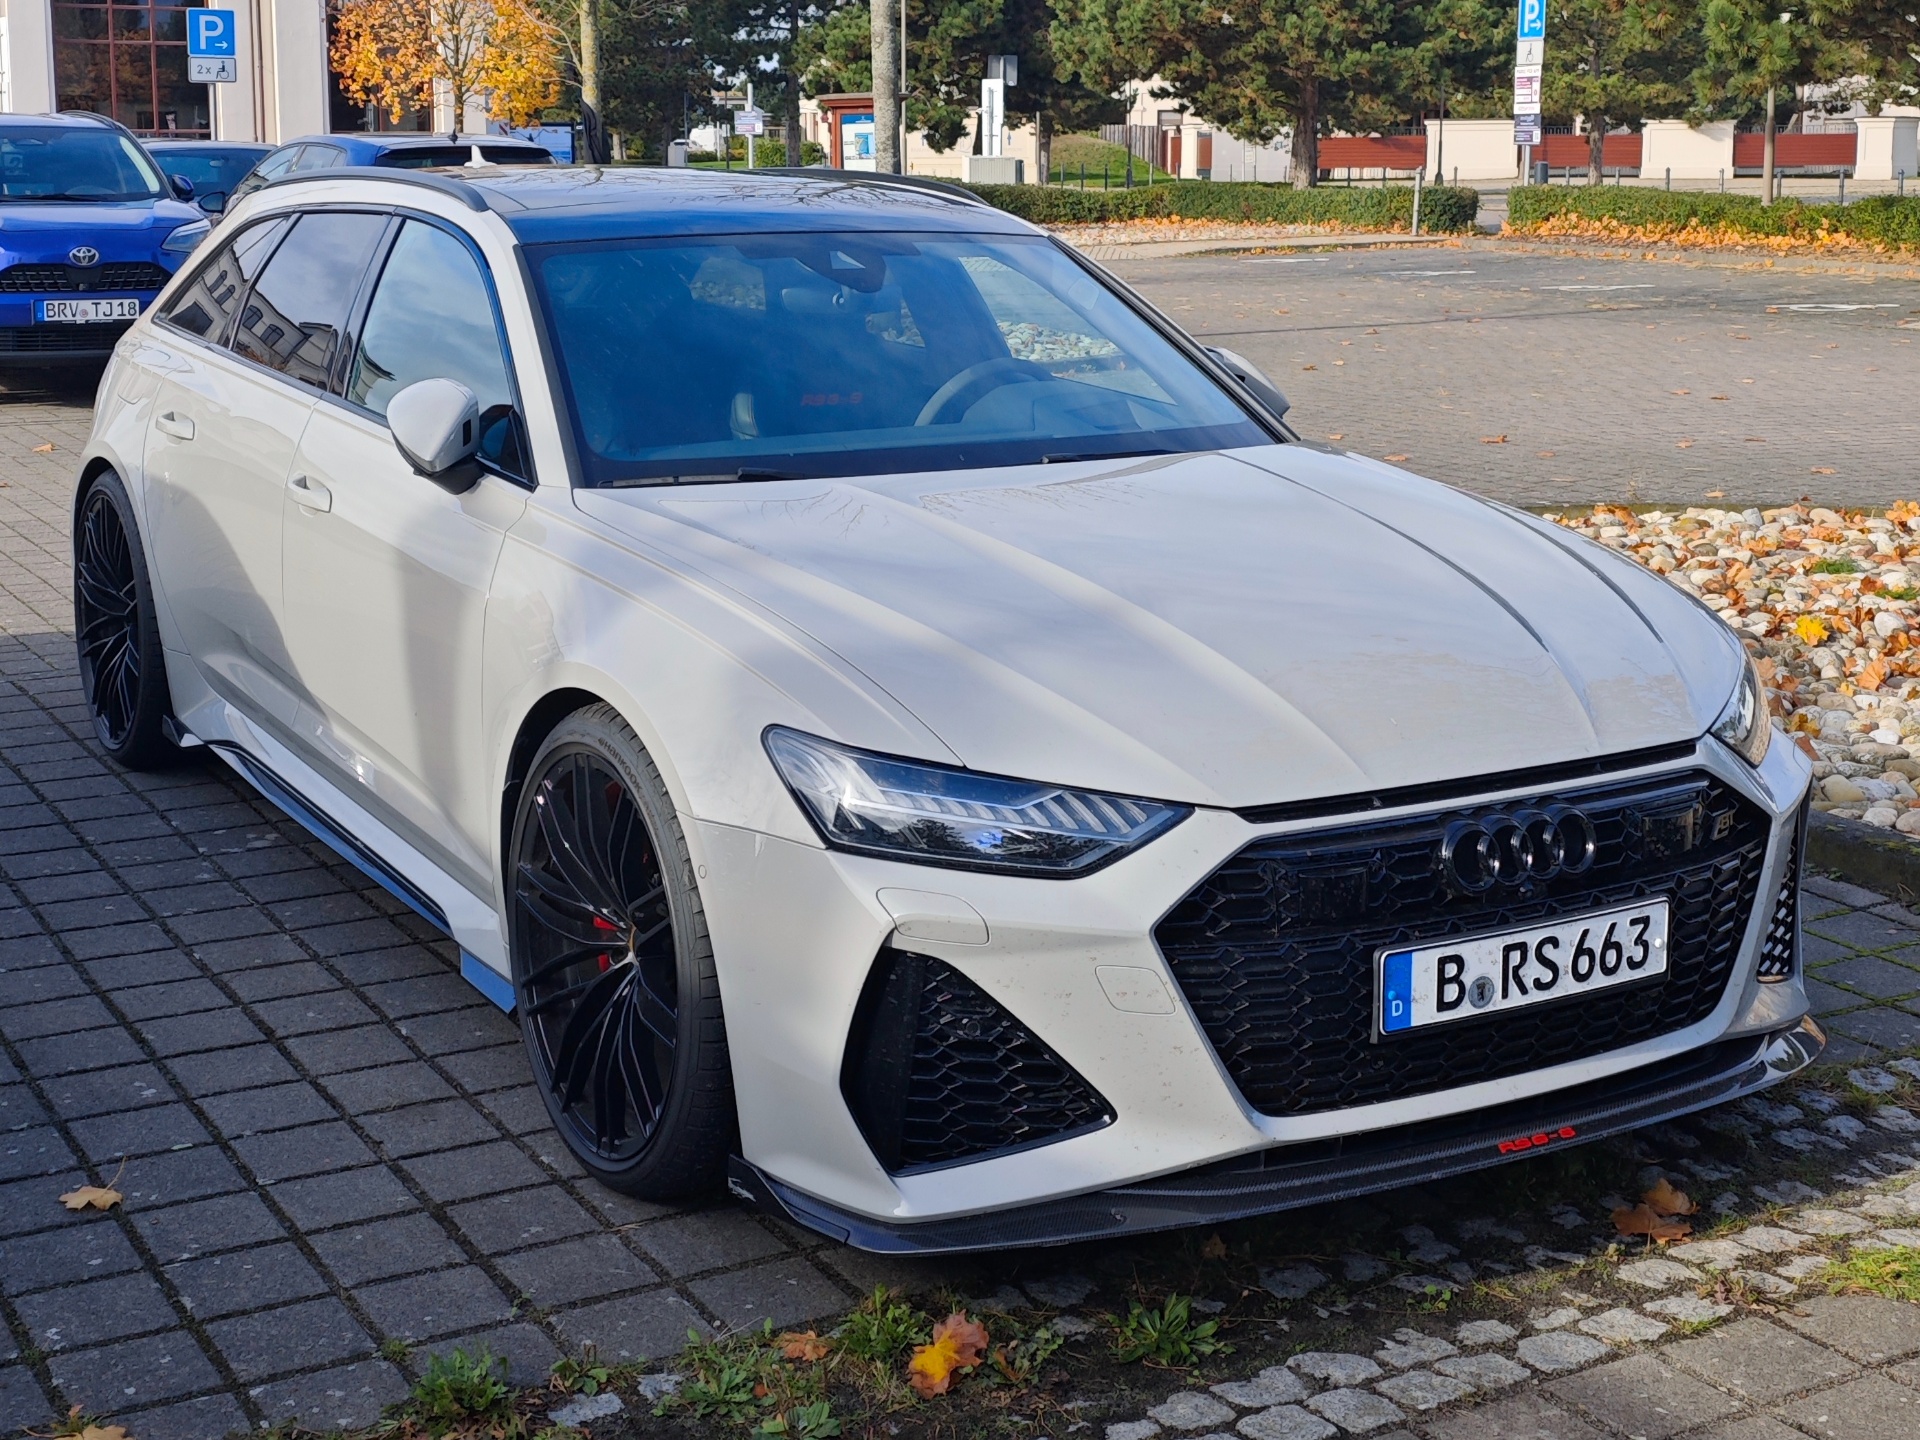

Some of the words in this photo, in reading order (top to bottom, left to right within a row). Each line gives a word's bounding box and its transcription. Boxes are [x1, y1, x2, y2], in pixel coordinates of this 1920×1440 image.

[199, 14, 224, 50] P
[1523, 0, 1540, 34] P
[196, 64, 204, 74] 2
[45, 302, 79, 319] BRV
[1391, 1000, 1403, 1017] D
[1436, 953, 1467, 1013] B
